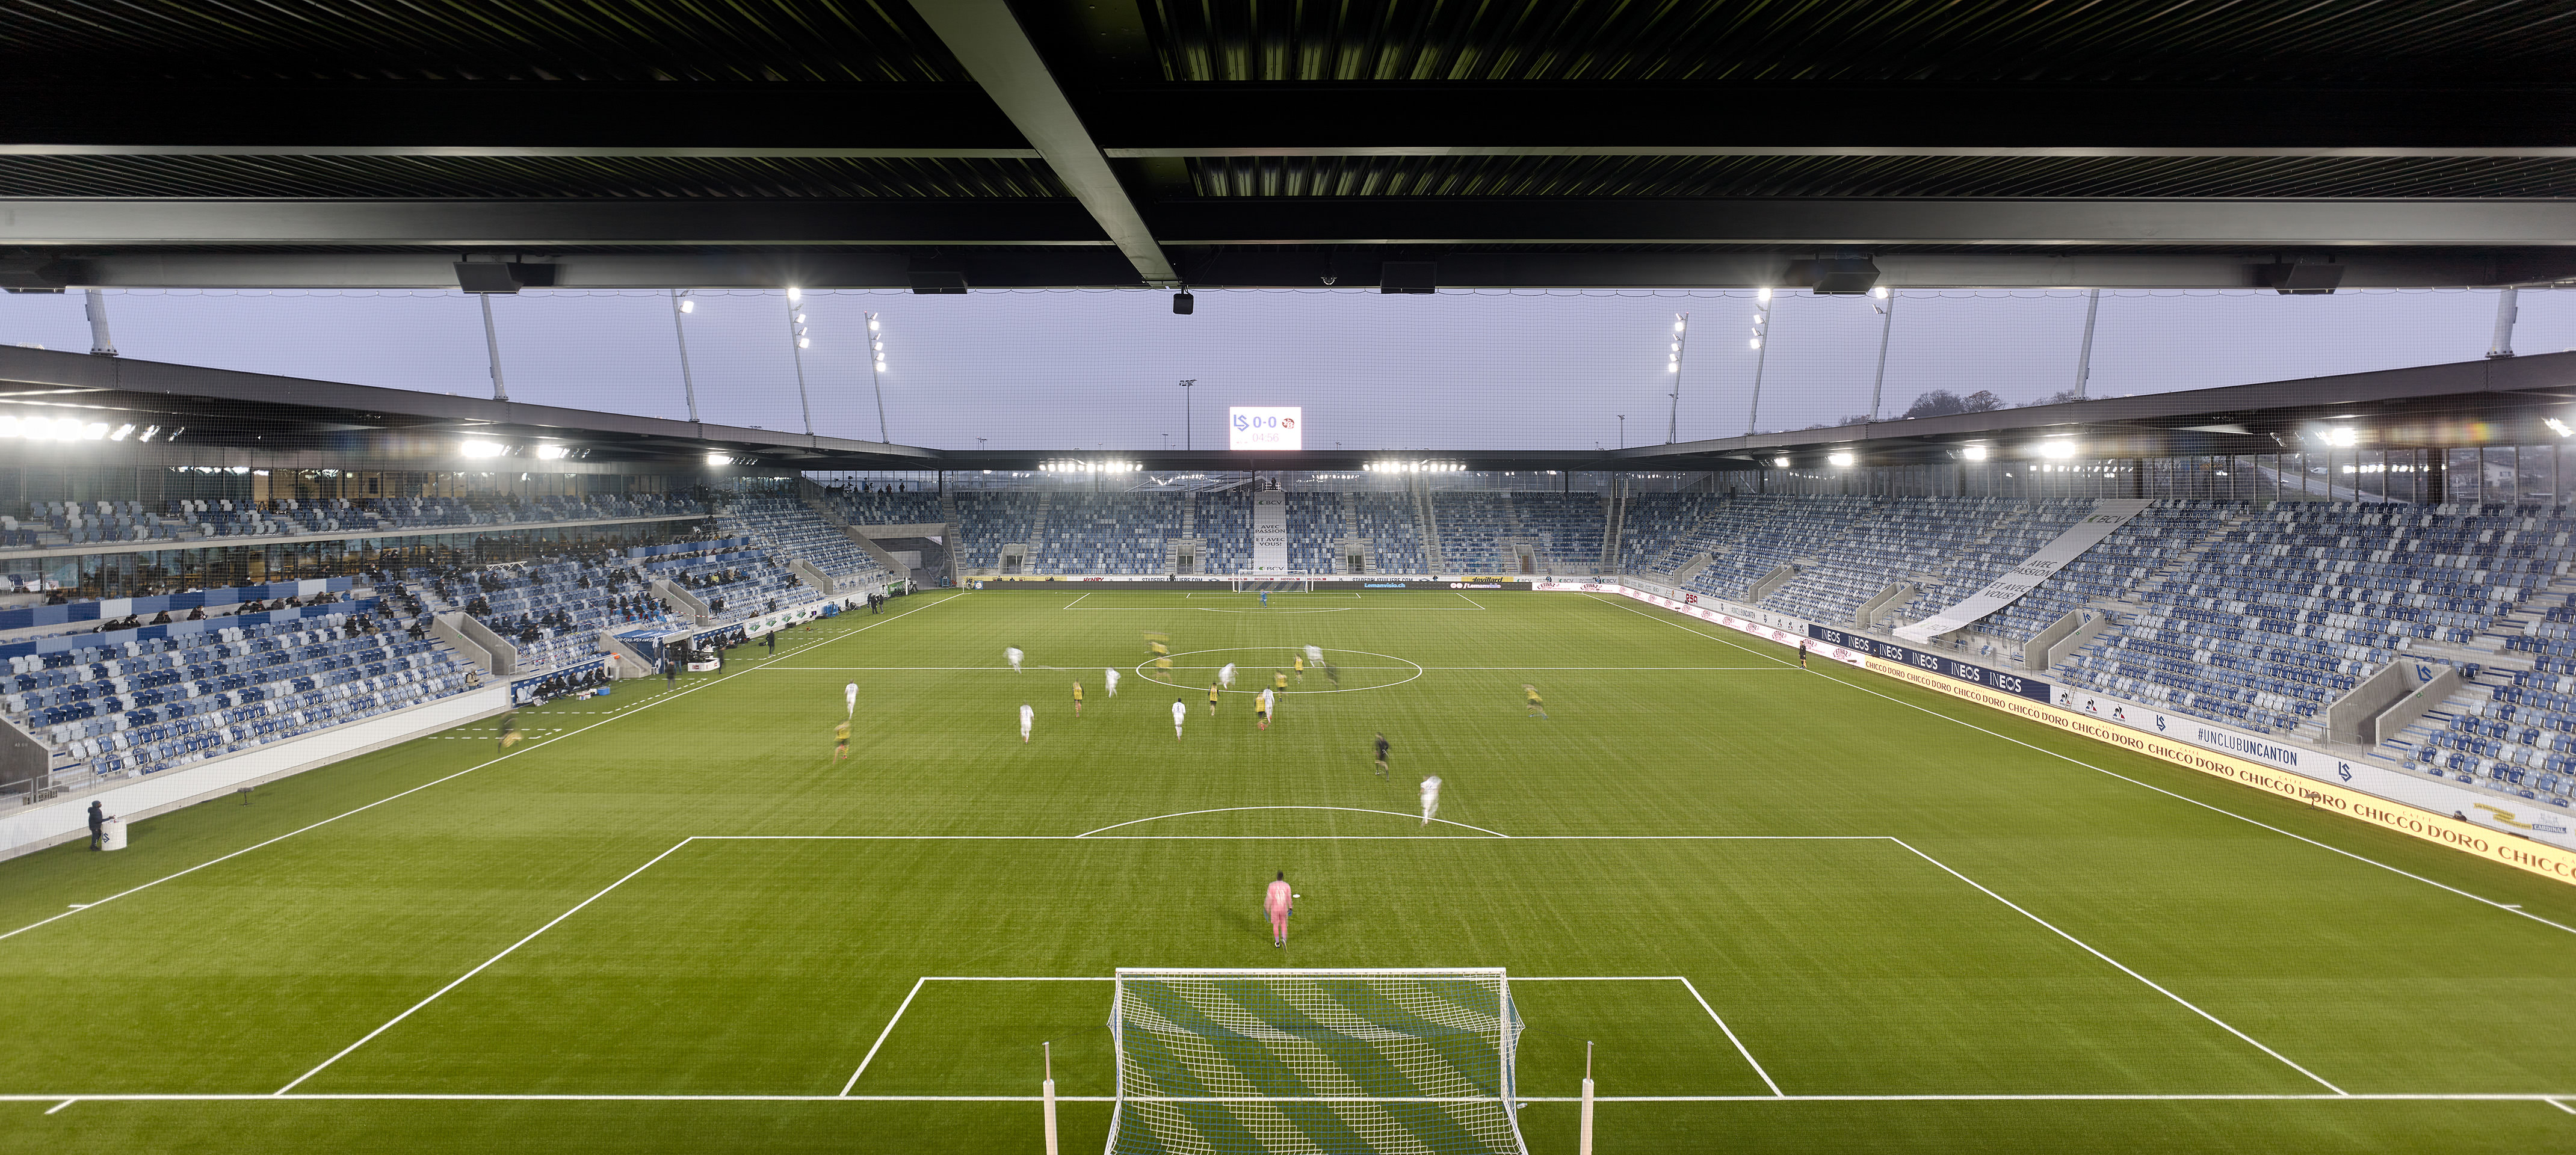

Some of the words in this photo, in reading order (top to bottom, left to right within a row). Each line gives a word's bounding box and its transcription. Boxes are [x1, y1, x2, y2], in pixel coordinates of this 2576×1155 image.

[2097, 515, 2127, 523] BCV
[2010, 567, 2055, 577] PASSION
[1984, 590, 2016, 600] VOUS!
[2000, 583, 2031, 593] AVEC
[1821, 629, 1841, 644] INEOS
[1849, 635, 1869, 651] INEOS
[1879, 644, 1902, 661] INEOS
[1912, 651, 1938, 670] INEOS
[1866, 661, 1887, 673] CHICCO
[1888, 668, 1905, 678] D'ORO
[1951, 662, 1980, 681] INEOS
[1907, 673, 1930, 686] CHICCO
[1932, 680, 1951, 692] D'ORO
[1989, 672, 2022, 693] INEOS
[1954, 686, 1981, 701] CHICCO
[1983, 694, 2006, 708] D'ORO
[2009, 703, 2040, 719] CHICCO
[2042, 712, 2068, 727] D'ORO
[2072, 721, 2109, 739] CHICCO
[2112, 733, 2143, 750] D'ORO
[2198, 728, 2297, 766] #UNCLUBUNCANTON
[2148, 744, 2193, 764] CHICCO
[2196, 757, 2234, 777] D'ORO
[2240, 771, 2295, 794] CHICCO
[2299, 787, 2346, 810] D'ORO
[2353, 804, 2423, 833] CHICCO
[2428, 825, 2489, 852] D'ORO
[2534, 824, 2566, 833] CARDINAL
